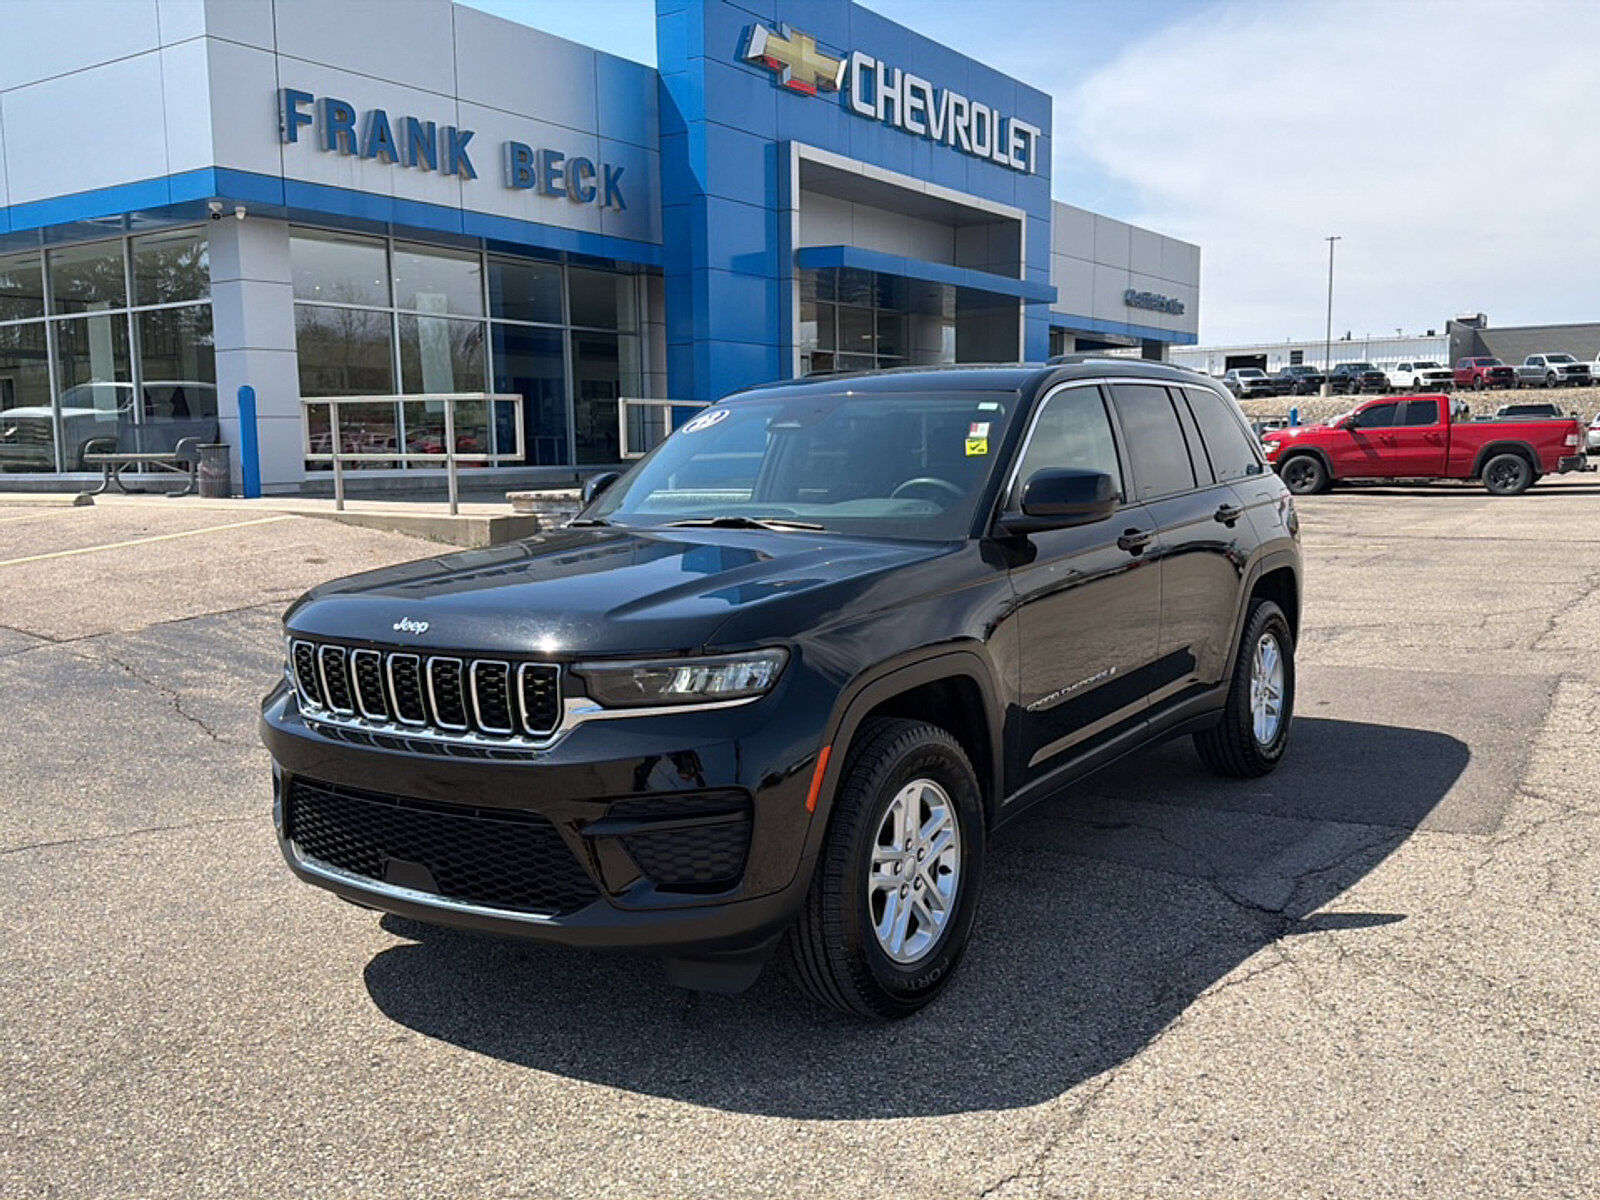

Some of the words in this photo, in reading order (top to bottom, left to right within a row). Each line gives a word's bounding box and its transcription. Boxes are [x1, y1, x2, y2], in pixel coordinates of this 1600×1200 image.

[281, 87, 478, 180] FRANK
[502, 139, 627, 211] BECK
[851, 50, 1042, 175] CHEVROLET
[393, 616, 430, 635] Jeep
